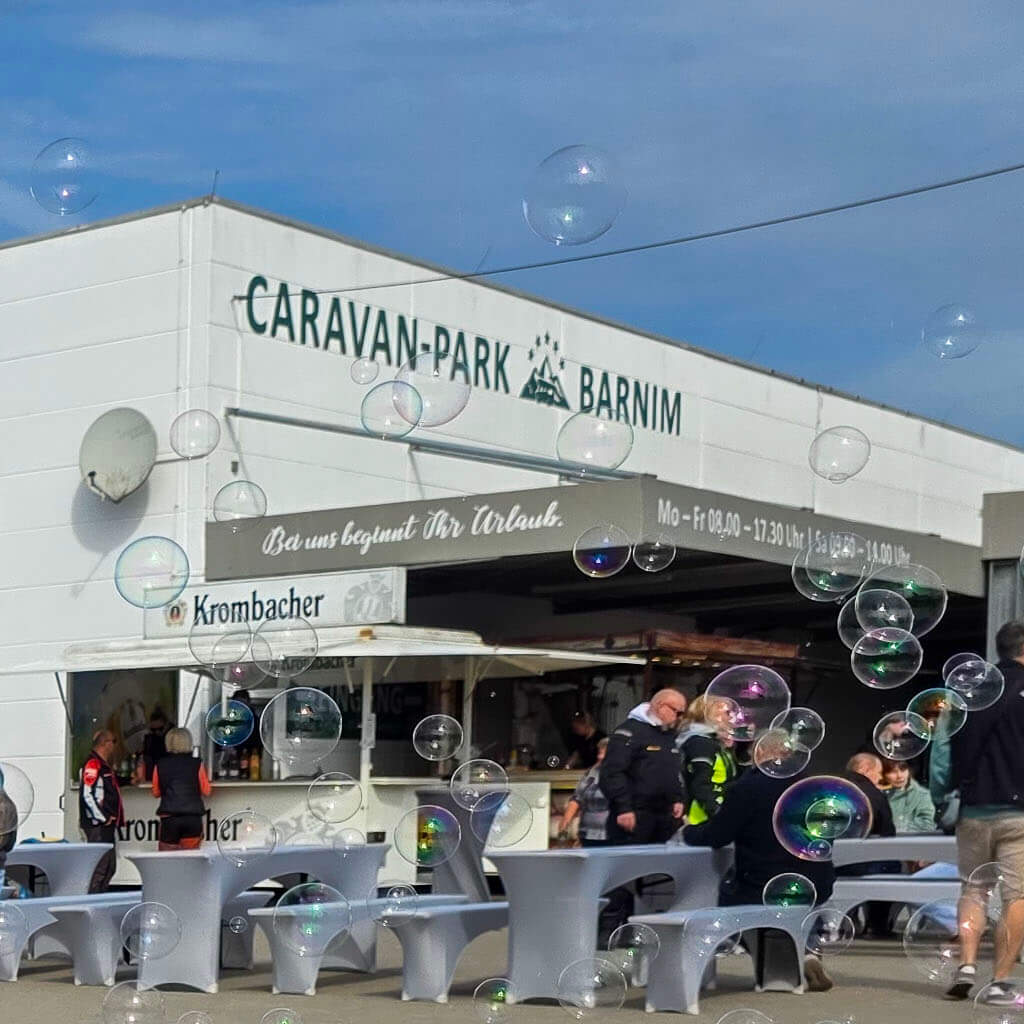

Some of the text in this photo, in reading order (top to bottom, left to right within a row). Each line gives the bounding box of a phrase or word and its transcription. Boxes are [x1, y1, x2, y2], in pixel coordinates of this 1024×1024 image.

[246, 276, 682, 436] CARAVAN-PARK BARNIM
[262, 500, 564, 556] Bei uns beginnt Ihr Urlaub.
[657, 498, 679, 527] Mo
[694, 505, 705, 531] Fr
[754, 517, 784, 546] 17.30
[786, 523, 804, 550] Uhr
[194, 587, 325, 626] Krombacher
